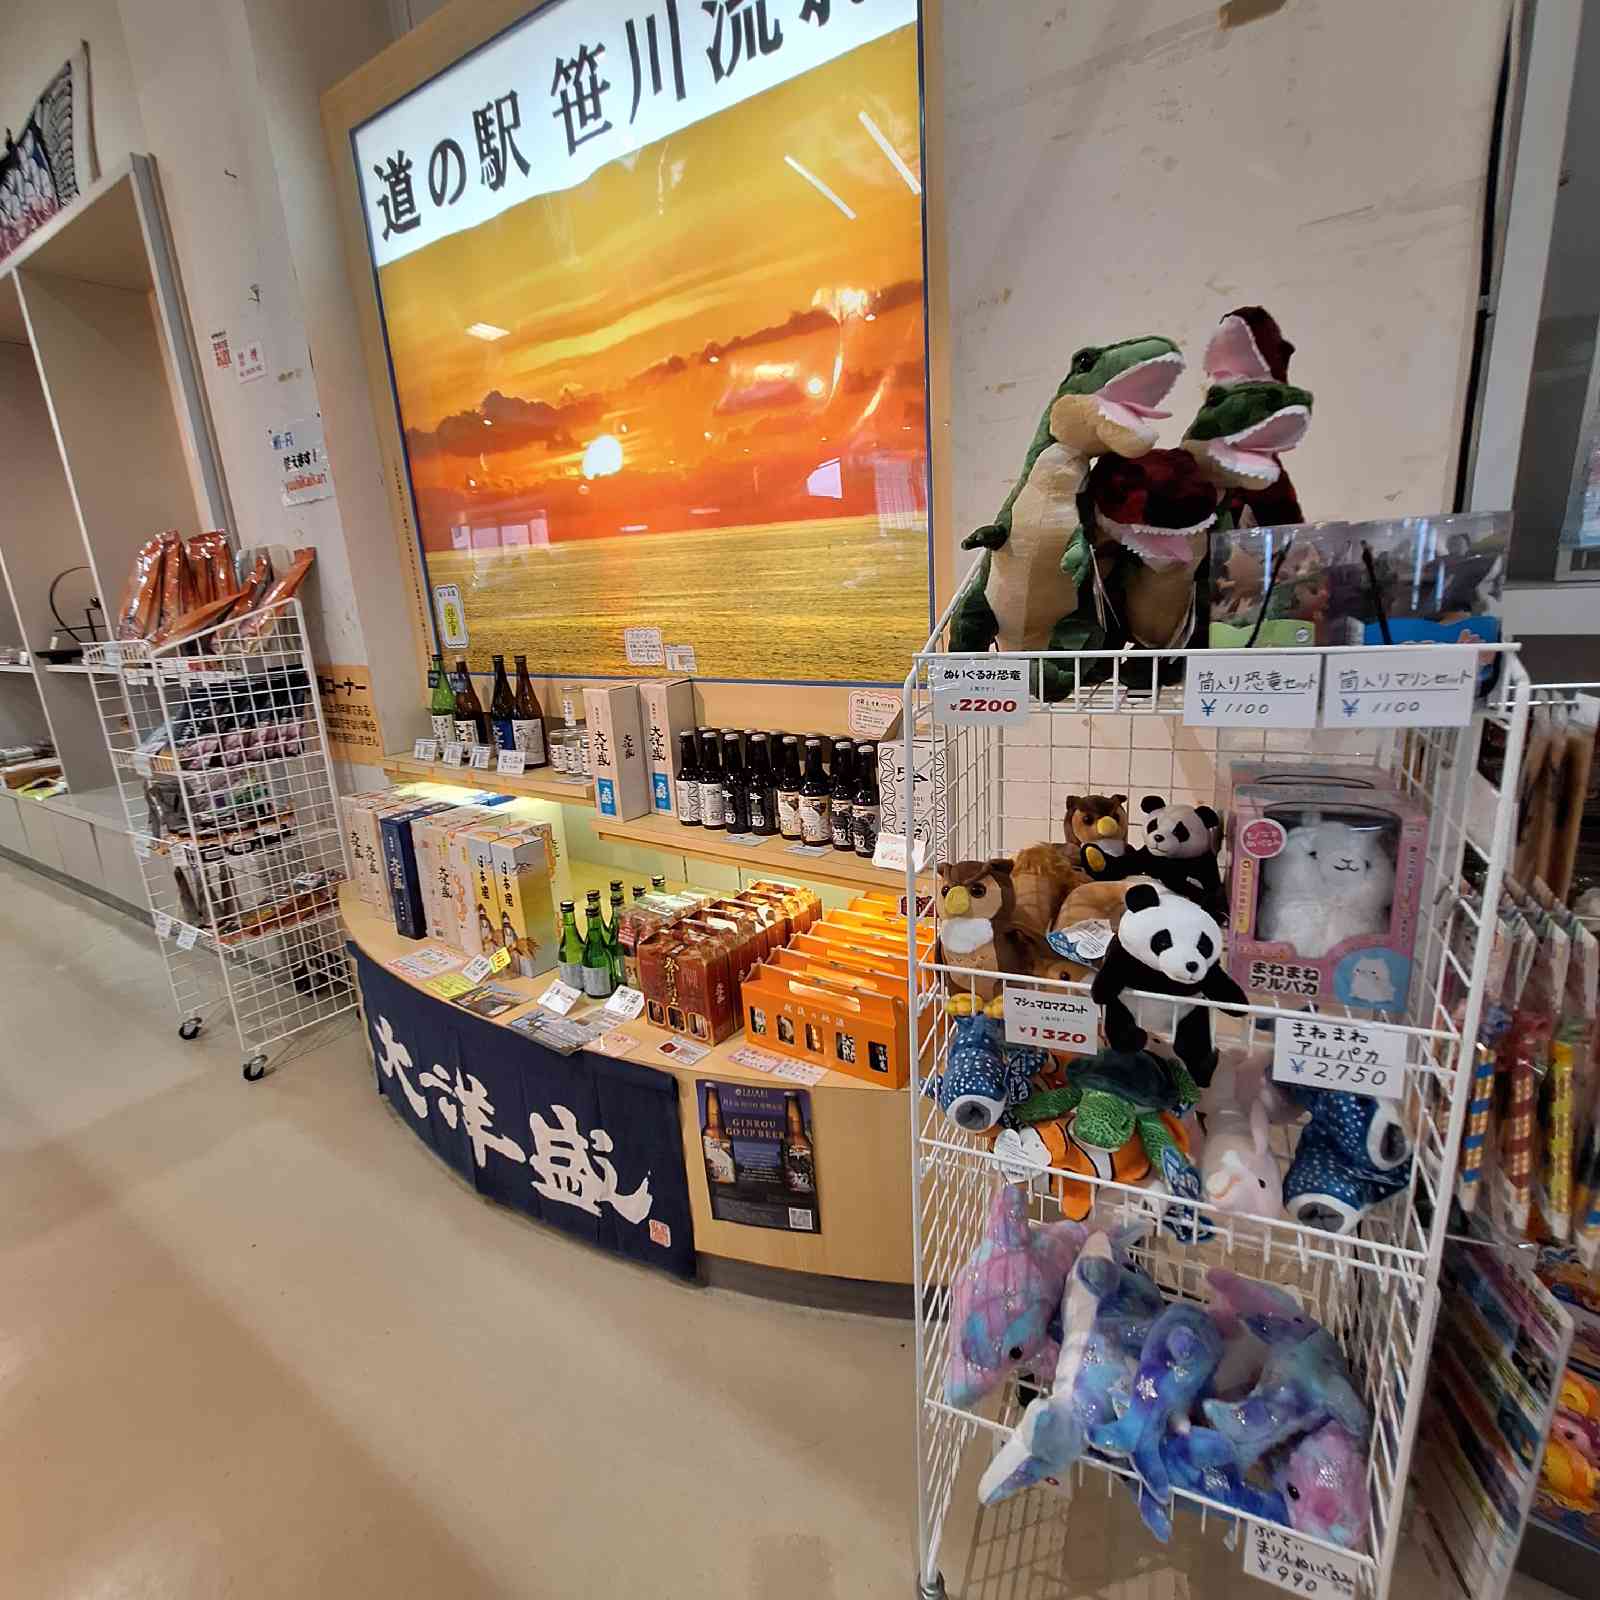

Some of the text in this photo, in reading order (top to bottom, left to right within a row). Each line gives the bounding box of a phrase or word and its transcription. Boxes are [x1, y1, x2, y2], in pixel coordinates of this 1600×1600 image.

[374, 0, 866, 241] 道の駅 笹川流
[944, 669, 1022, 681] ぬいぐるみ恐竜
[1251, 961, 1320, 983] まねまね
[1013, 996, 1088, 1014] マシュマロマスコット
[1292, 1022, 1370, 1044] まねまね
[1295, 1040, 1380, 1065] アルパカ
